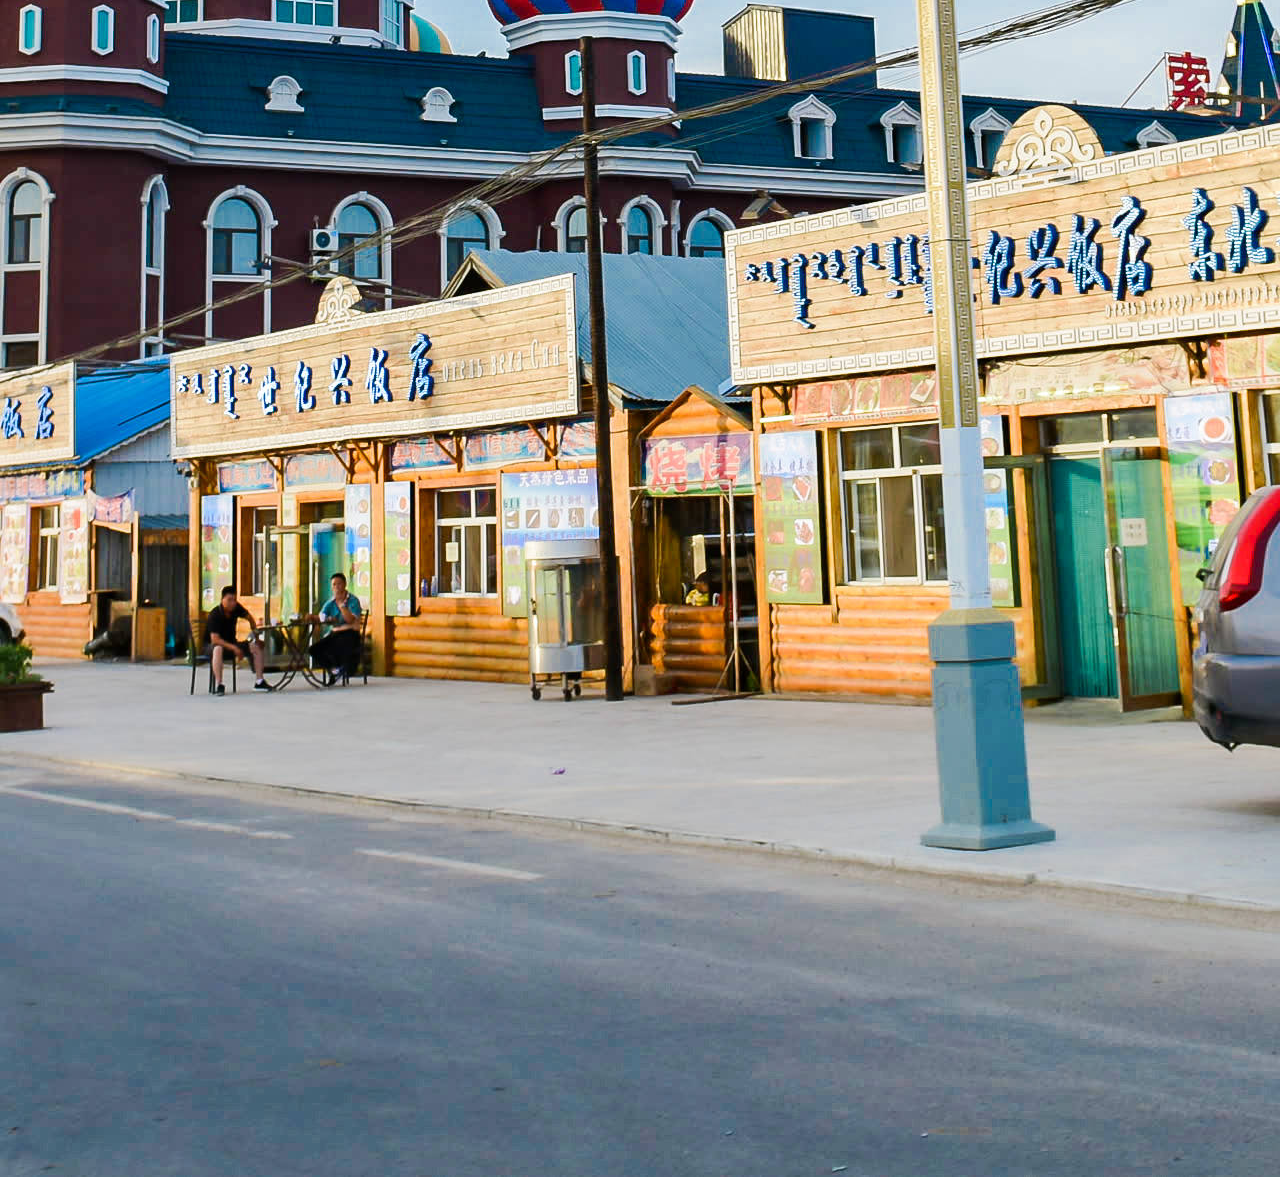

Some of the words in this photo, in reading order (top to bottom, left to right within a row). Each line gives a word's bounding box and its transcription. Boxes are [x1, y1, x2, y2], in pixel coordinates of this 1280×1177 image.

[971, 195, 1154, 306] 纪兴饭店
[646, 439, 741, 493] 烧烤
